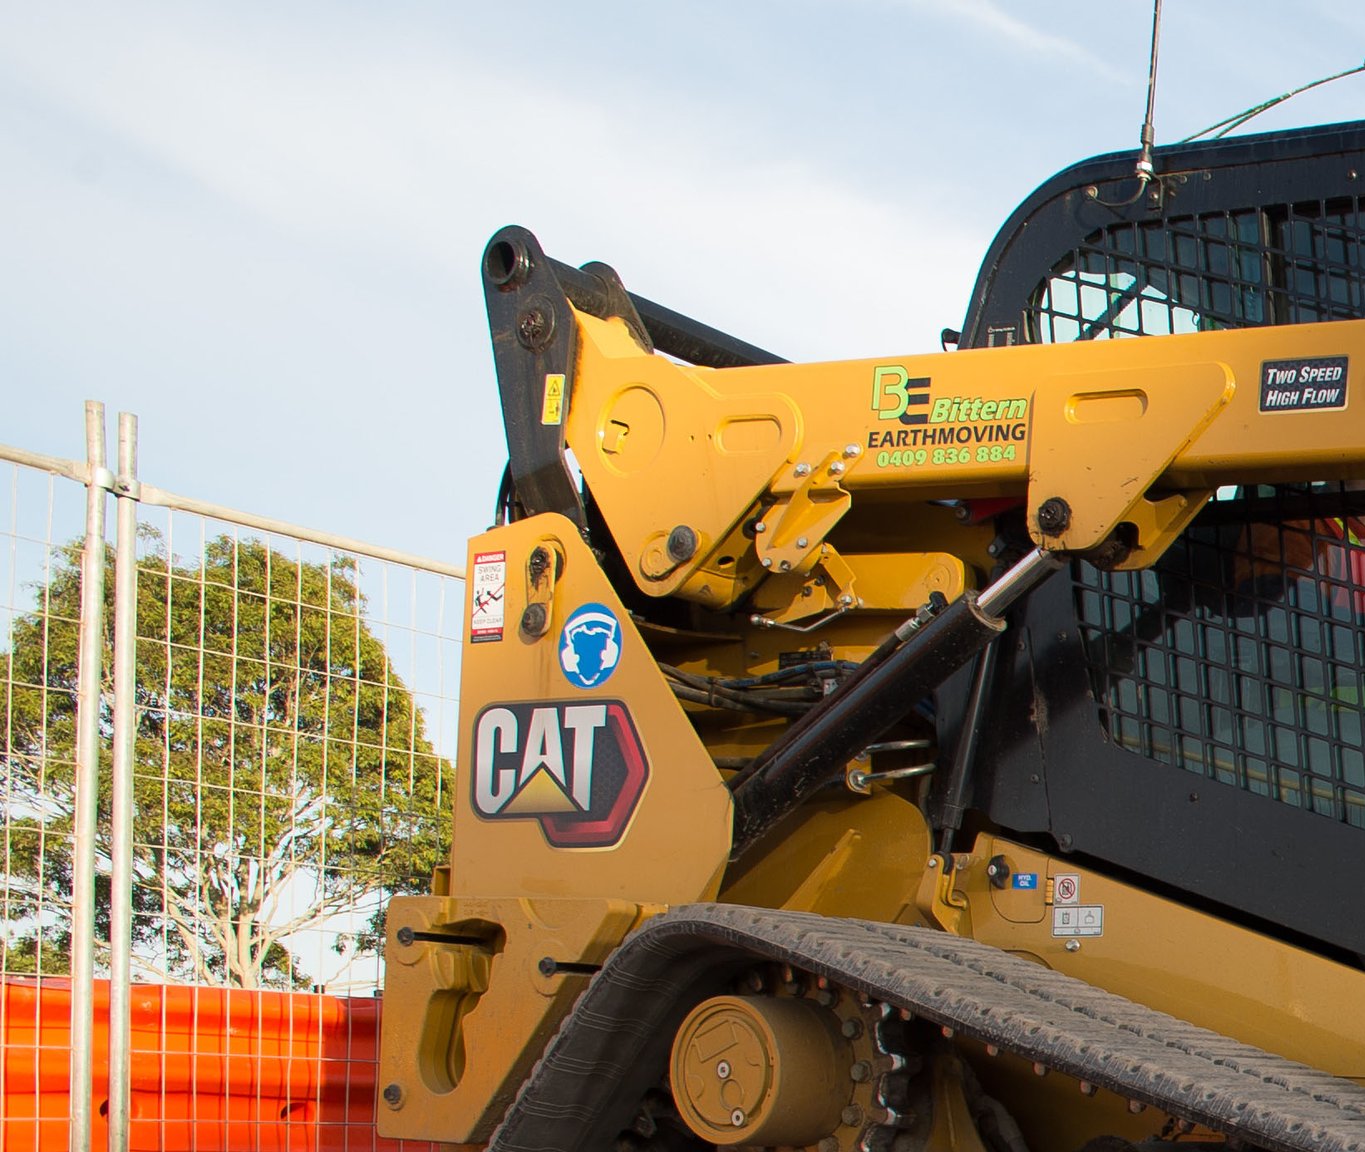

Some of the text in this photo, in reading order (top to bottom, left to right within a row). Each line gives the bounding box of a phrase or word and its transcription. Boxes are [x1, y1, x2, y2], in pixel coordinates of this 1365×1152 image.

[929, 397, 1028, 425] Bittern
[867, 423, 1026, 448] EARTHMOVING
[877, 444, 1016, 468] 0409 836 884
[478, 565, 501, 575] SWING
[476, 705, 607, 814] CAT
